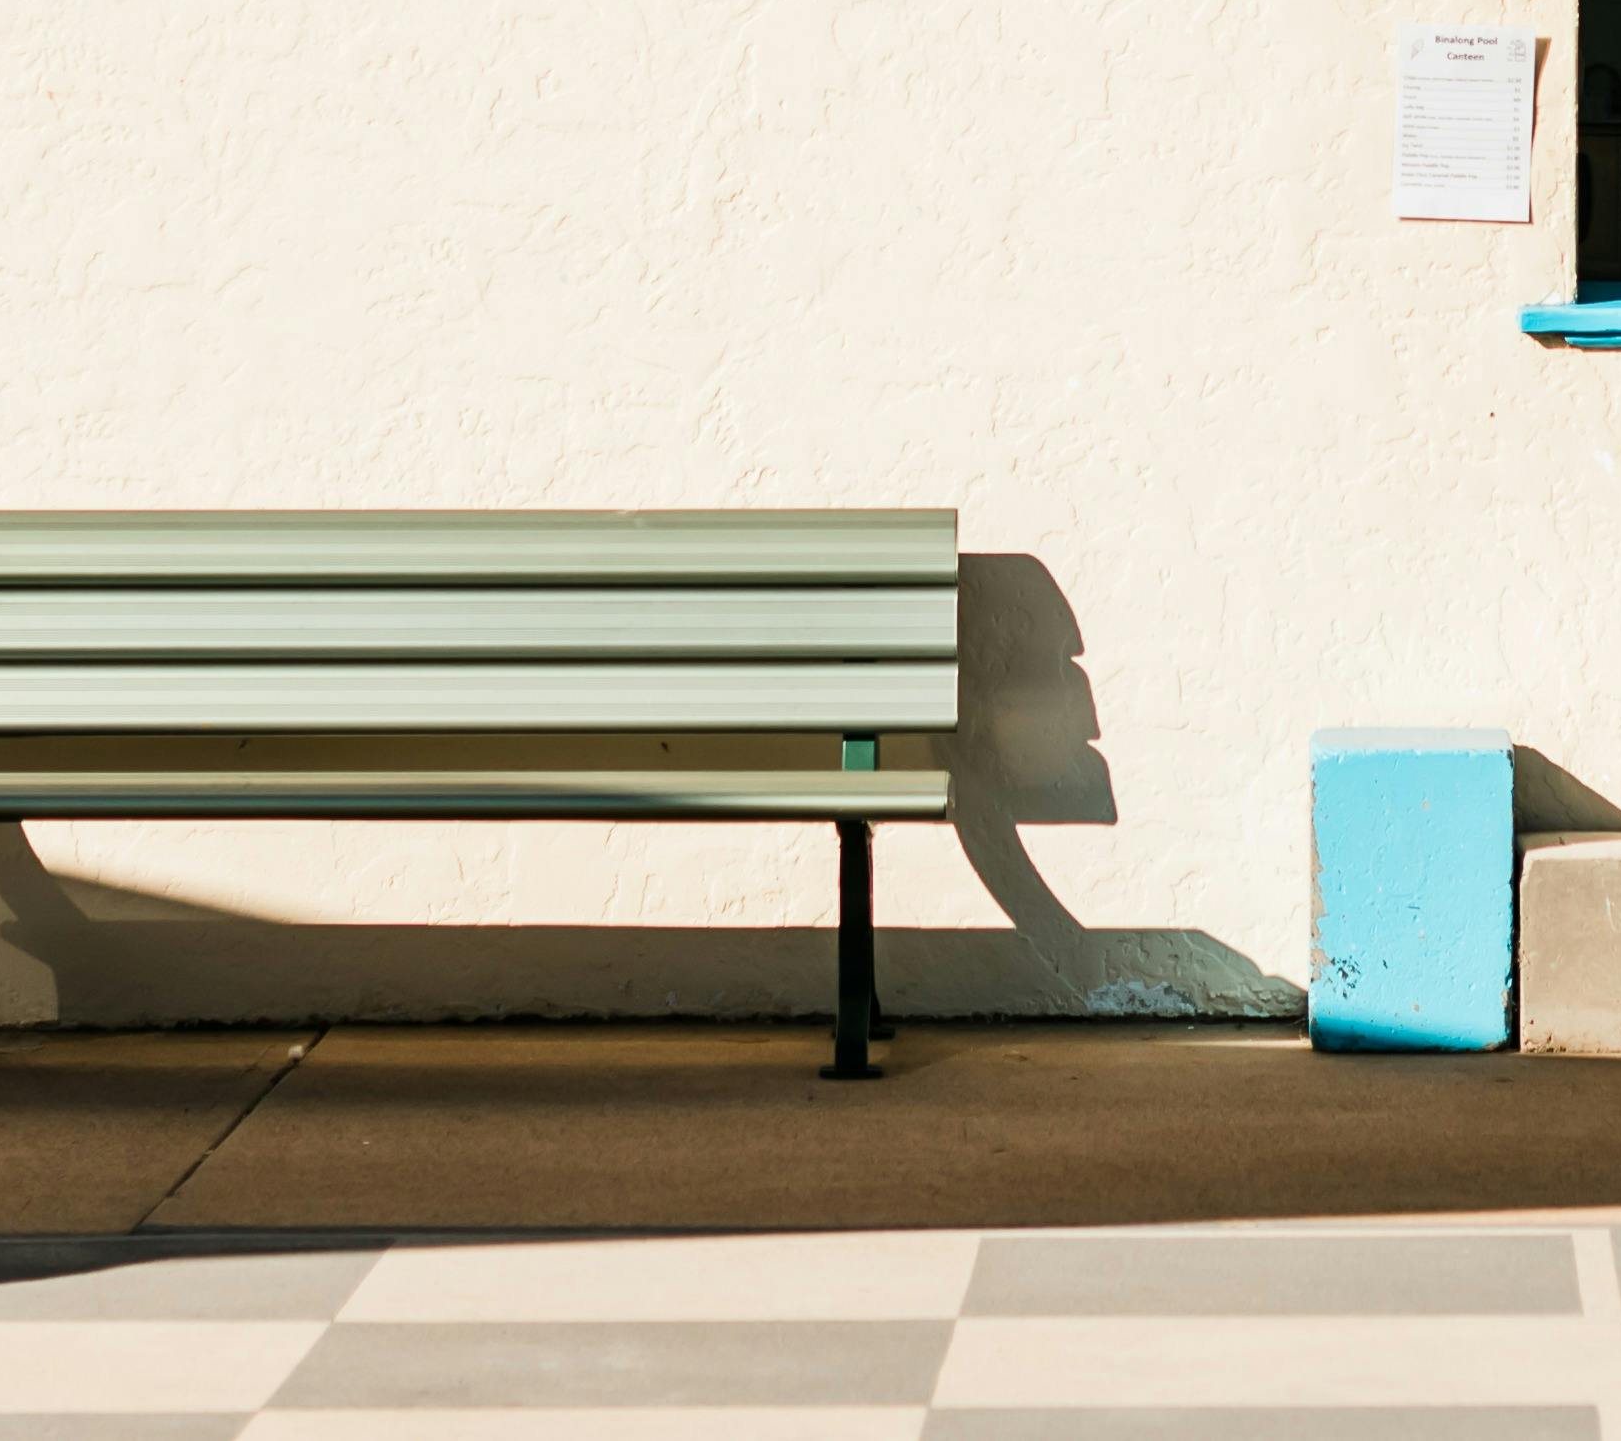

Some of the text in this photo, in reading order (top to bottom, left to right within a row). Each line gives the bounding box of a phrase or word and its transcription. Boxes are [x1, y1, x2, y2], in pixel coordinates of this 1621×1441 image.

[1434, 36, 1498, 46] Binalong Pool
[1447, 52, 1485, 61] Canteen
